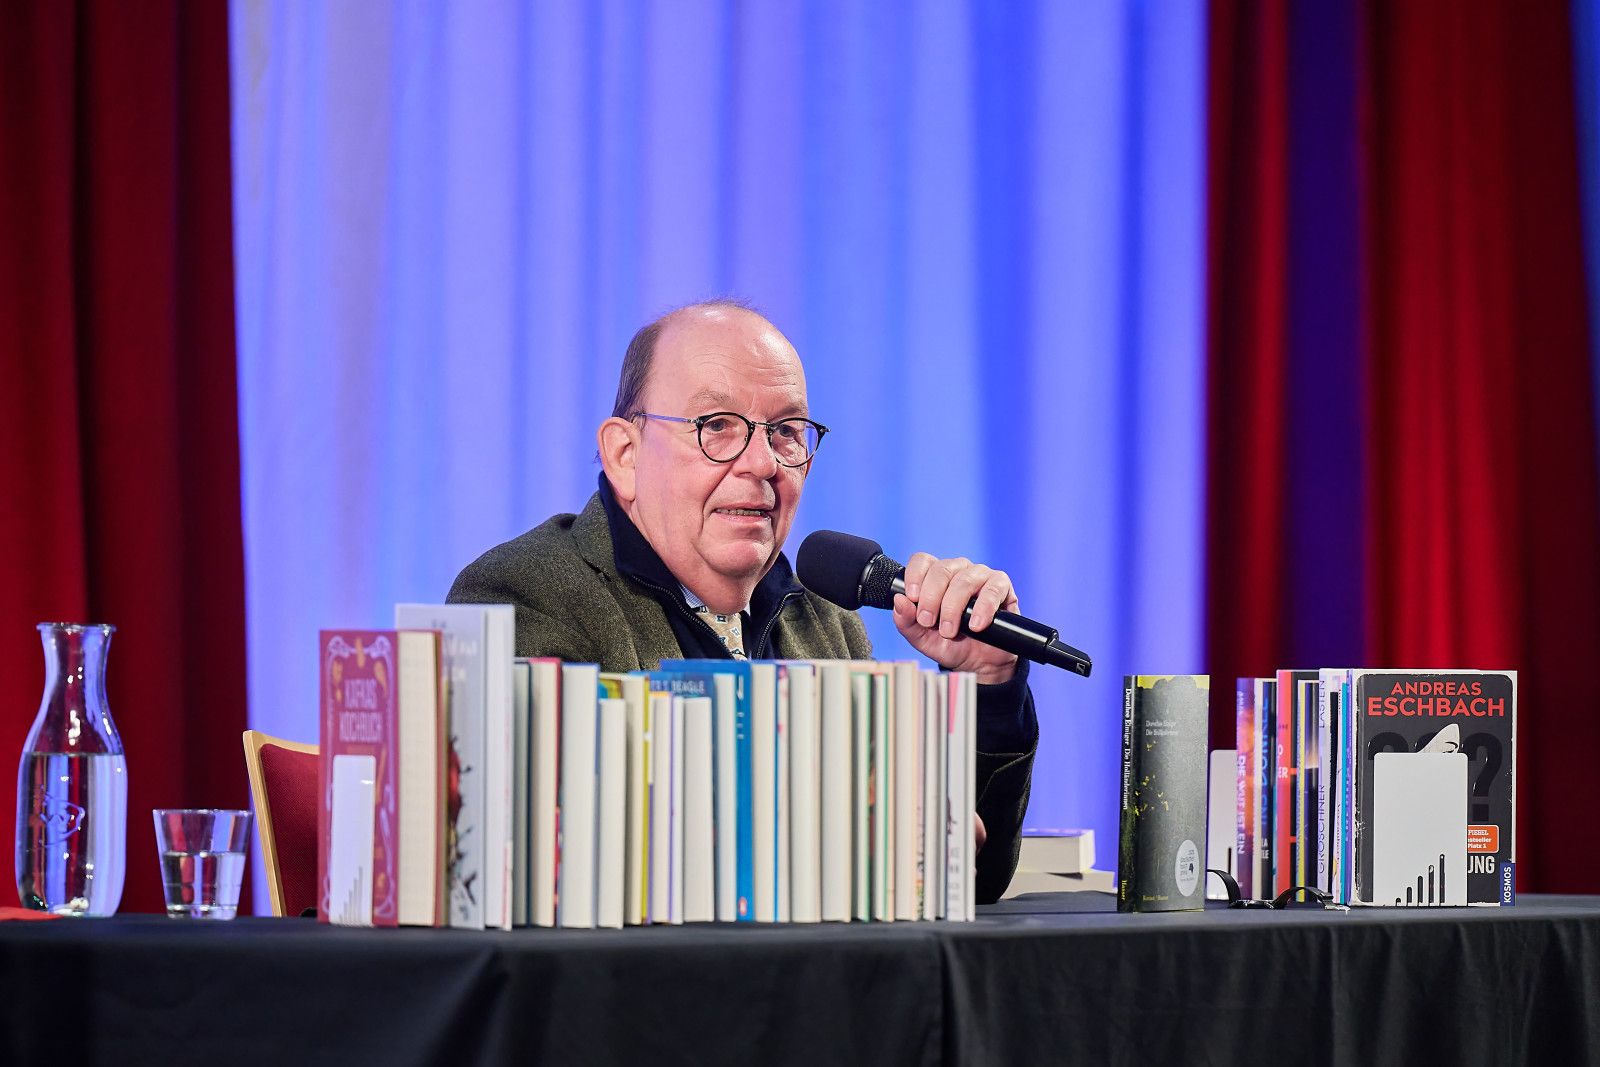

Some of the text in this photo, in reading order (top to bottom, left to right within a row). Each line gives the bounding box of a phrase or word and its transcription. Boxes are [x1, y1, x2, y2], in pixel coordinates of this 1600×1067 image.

[1391, 681, 1482, 696] ANDREAS
[1367, 696, 1505, 717] ESCHBACH
[1237, 755, 1247, 777] DIE
[1237, 811, 1245, 830] IST
[1237, 833, 1246, 855] EIN
[1503, 866, 1512, 903] KOSMOS
